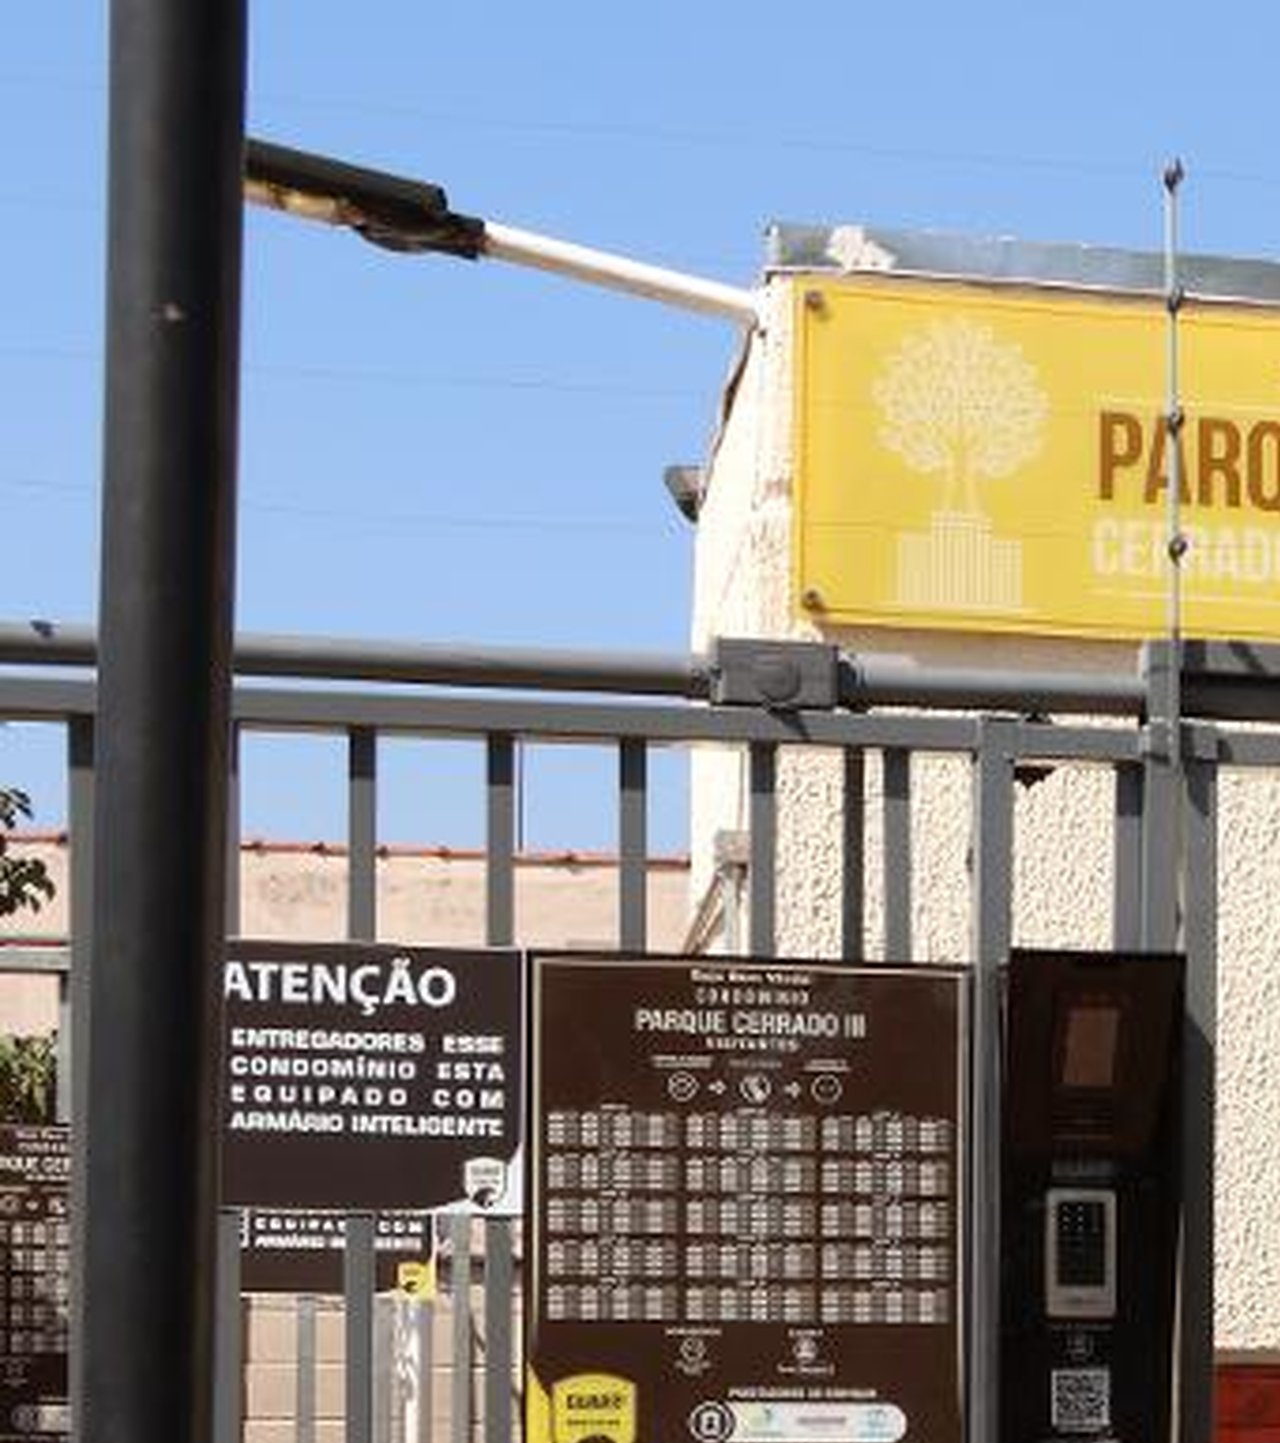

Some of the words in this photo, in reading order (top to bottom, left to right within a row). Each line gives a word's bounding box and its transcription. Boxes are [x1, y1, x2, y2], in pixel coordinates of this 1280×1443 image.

[223, 957, 457, 1016] ATENÇÃO
[635, 1009, 728, 1035] PARQUE
[732, 1011, 840, 1038] CERRADO
[230, 1028, 426, 1053] ENTREGADORES
[442, 1034, 505, 1054] ESSE
[230, 1055, 416, 1080] CONDOMÍNIO
[437, 1062, 506, 1081] ESTA
[230, 1084, 408, 1107] EQUIPADO
[432, 1088, 505, 1110] COM
[230, 1109, 344, 1133] ARMÁRIO
[351, 1114, 505, 1137] INTELIGENTE
